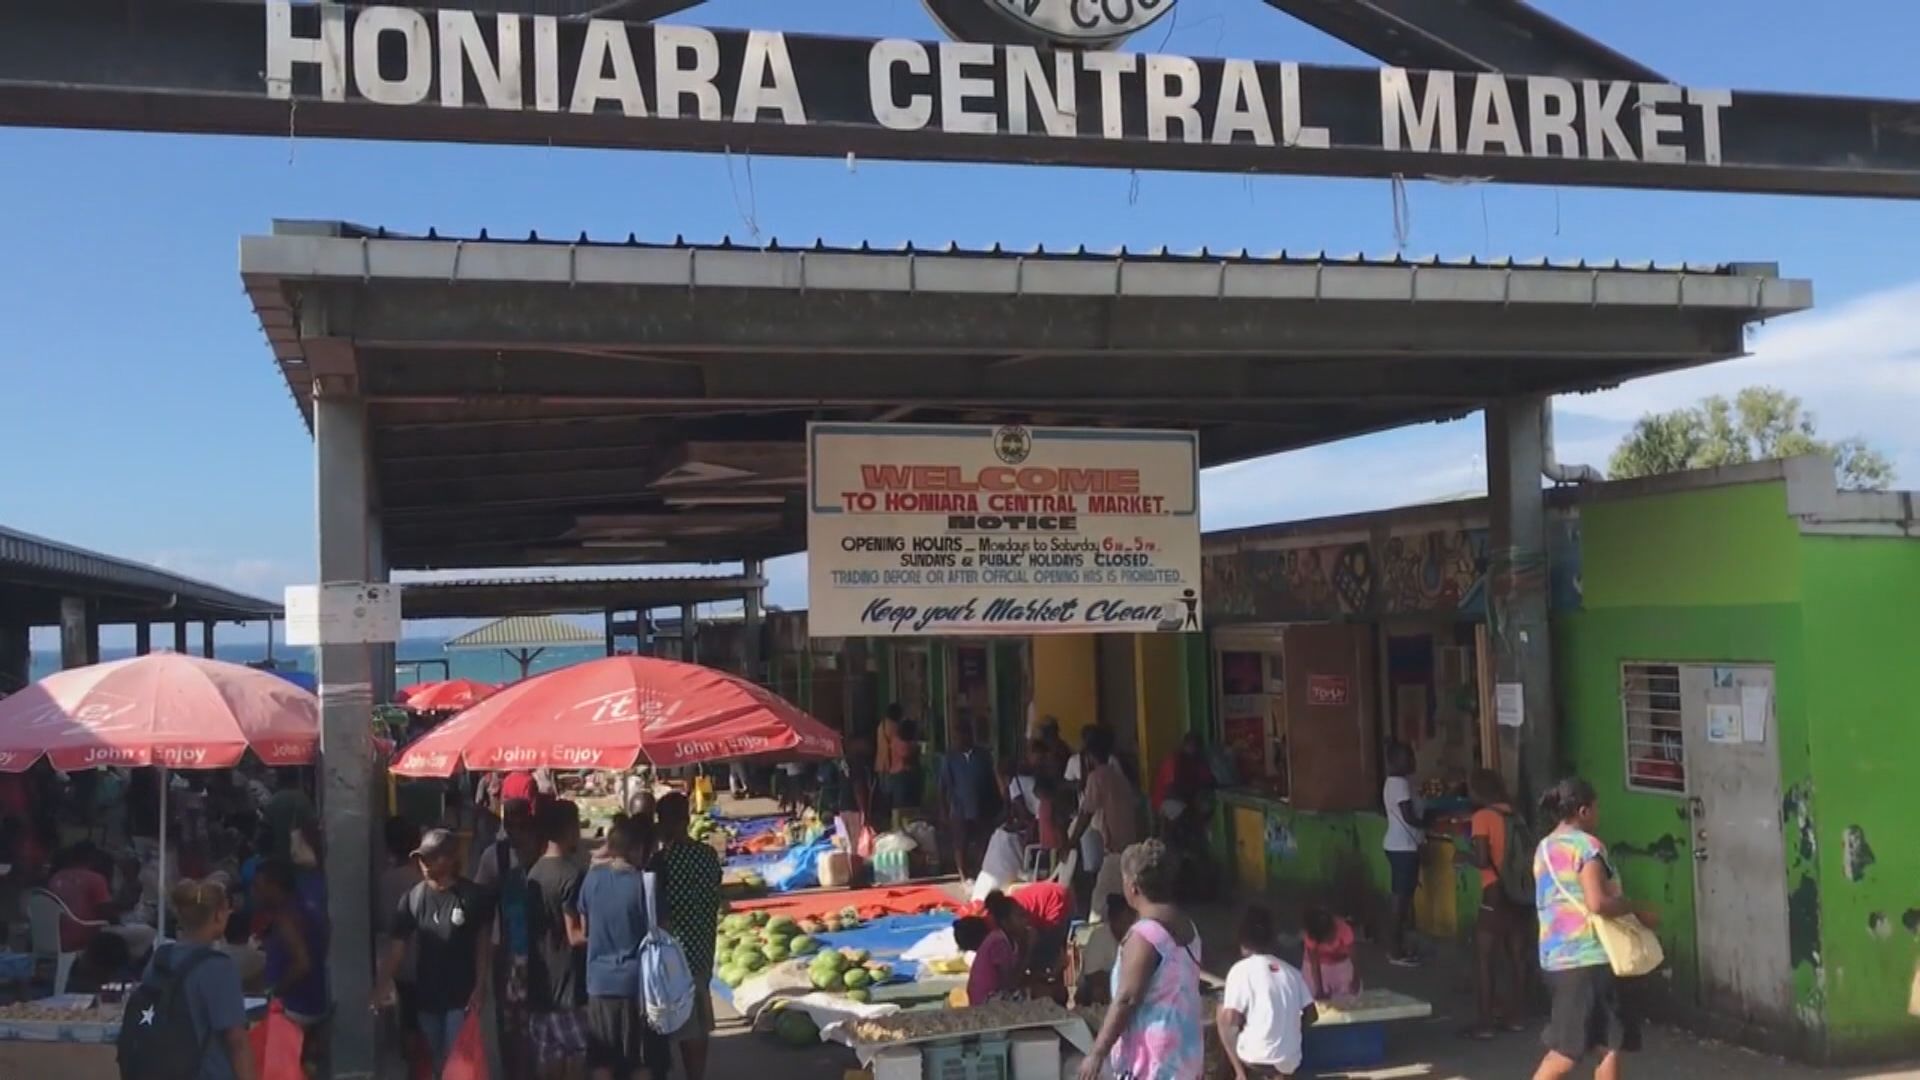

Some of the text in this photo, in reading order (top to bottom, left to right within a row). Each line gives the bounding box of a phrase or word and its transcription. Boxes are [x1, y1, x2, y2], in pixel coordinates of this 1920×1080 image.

[1070, 0, 1158, 29] CO
[265, 0, 1732, 167] HONIARA CENTRAL MARKET
[861, 465, 1140, 493] WELCOME
[842, 492, 876, 511] TO
[885, 493, 978, 512] HONIARA
[988, 495, 1077, 513] CENTRAL
[948, 516, 1077, 530] NOTICE
[841, 536, 905, 552] OPENING
[912, 537, 963, 551] HOURS
[979, 537, 1031, 556] Mondays
[1033, 537, 1047, 551] to
[1050, 538, 1101, 553] Saturday
[900, 554, 956, 567] SUNDAYS
[961, 556, 973, 567] &
[979, 554, 1023, 567] PUBLIC
[1029, 554, 1084, 567] HOLIDAYS
[831, 570, 880, 584] TRADING
[883, 570, 921, 584] BEFORE
[926, 571, 944, 584] OR
[948, 570, 978, 583] AFTER
[982, 570, 1028, 583] OFFICIAL
[1034, 570, 1079, 583] OPENING
[1107, 571, 1117, 583] IS
[861, 598, 1163, 633] Keep your Market Clean
[84, 746, 207, 763] John Enjoy
[491, 745, 603, 763] John Enjoy
[674, 735, 769, 758] John Enjoy
